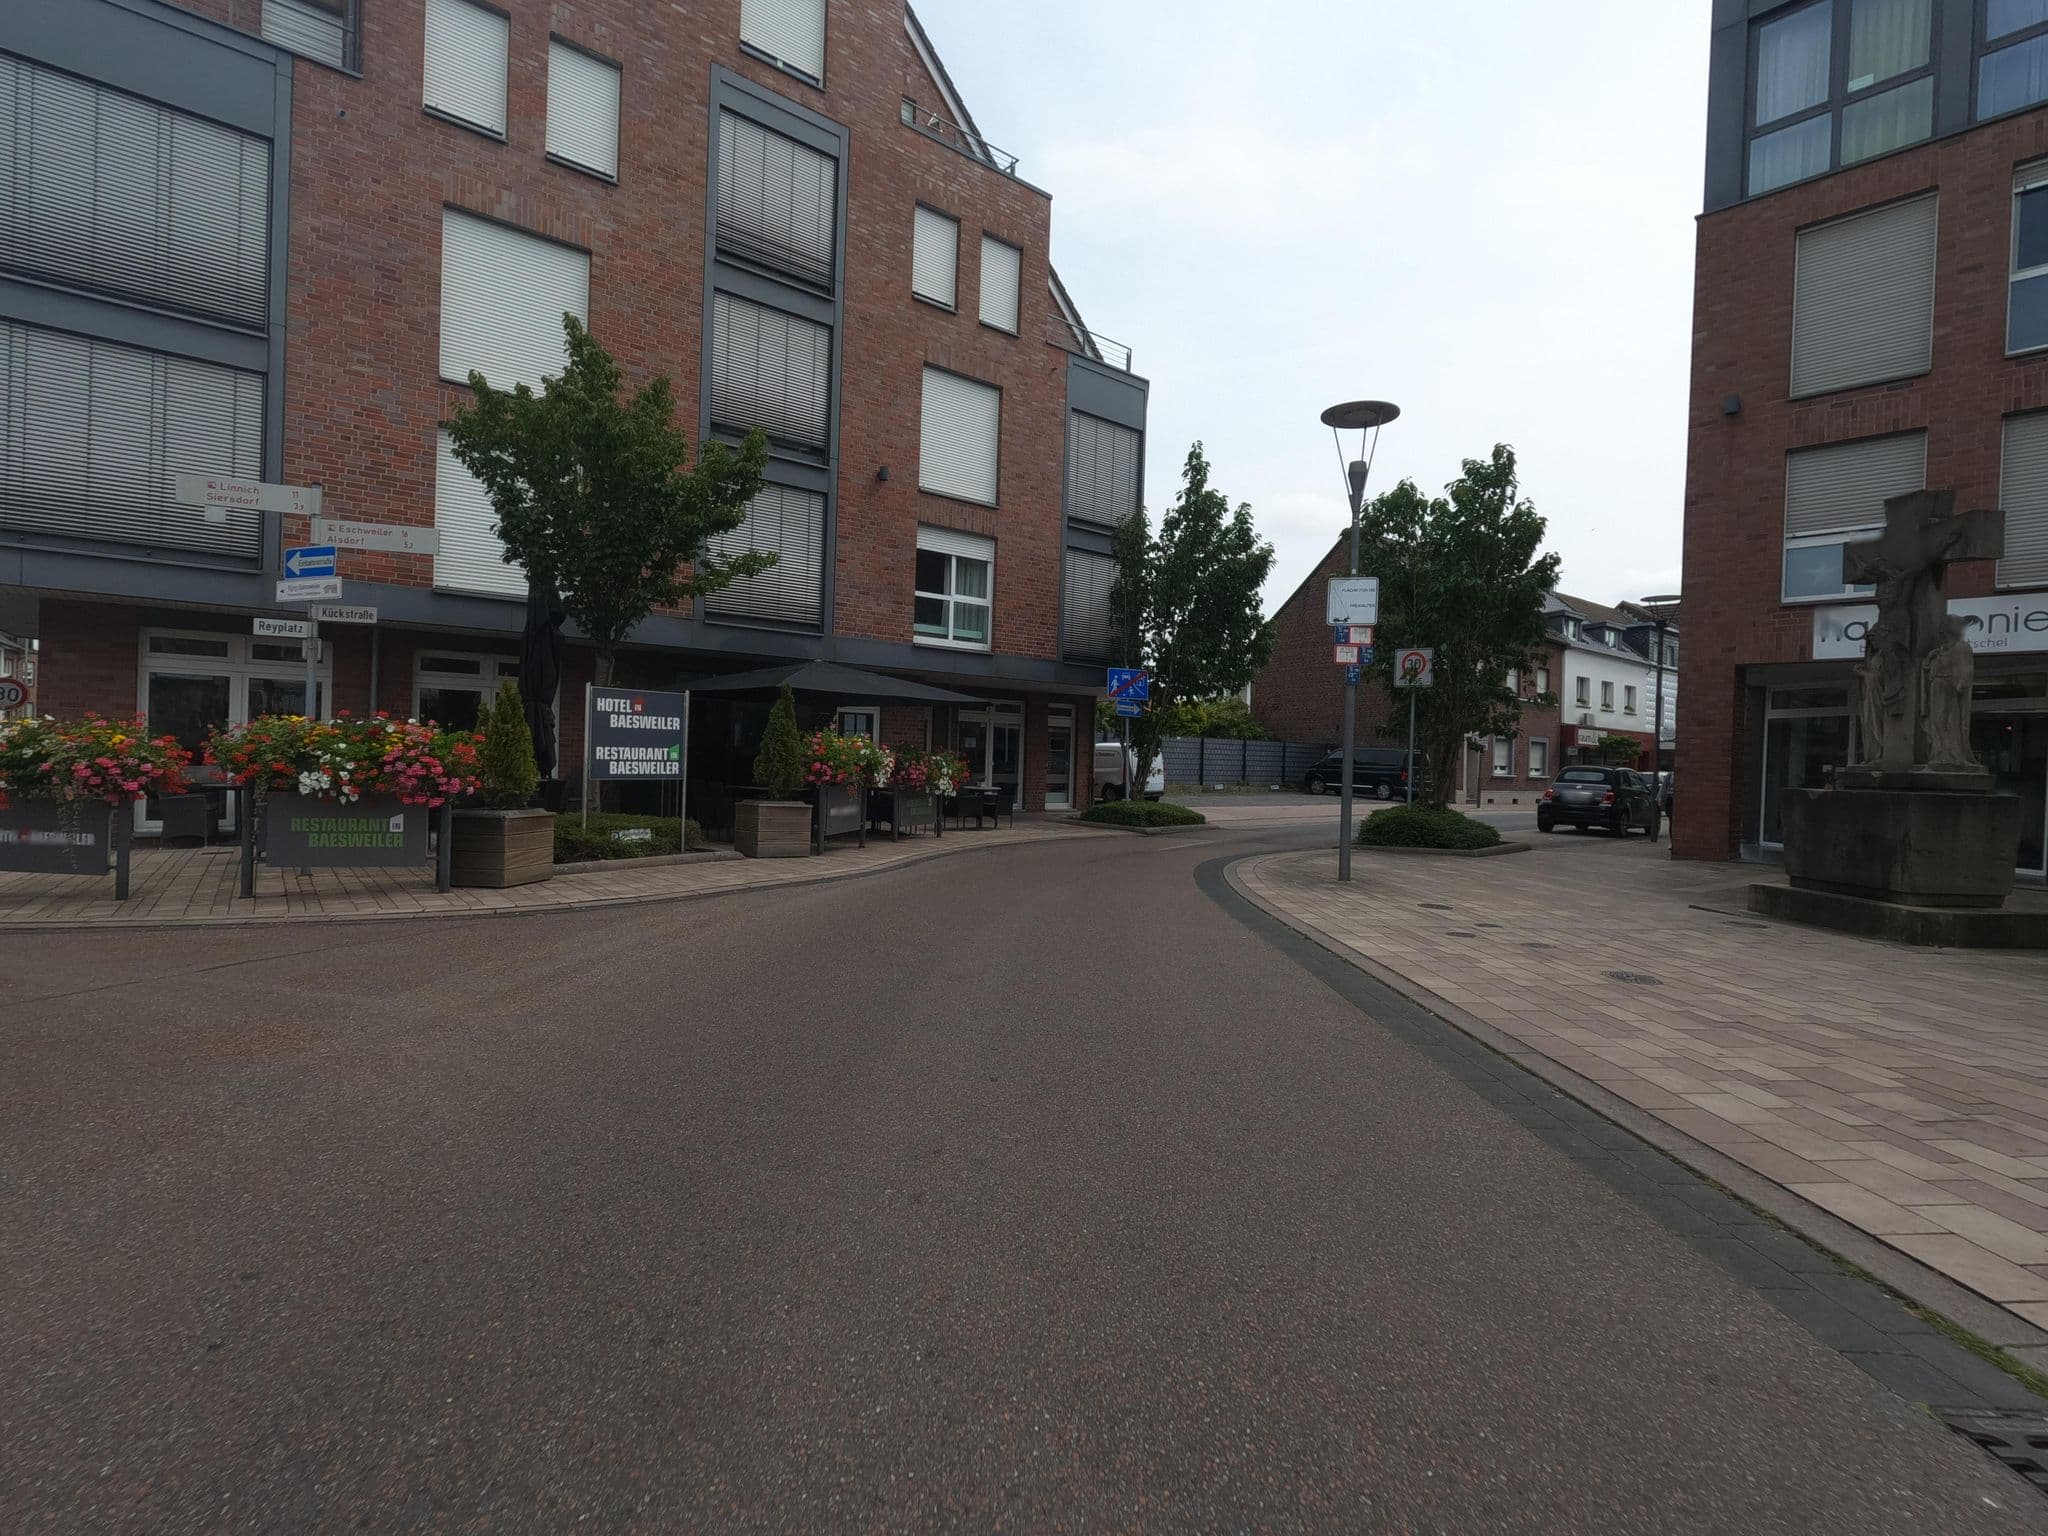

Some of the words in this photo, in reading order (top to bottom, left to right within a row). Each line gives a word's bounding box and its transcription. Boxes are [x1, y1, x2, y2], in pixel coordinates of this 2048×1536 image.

[220, 482, 260, 495] Linnich
[206, 492, 260, 506] Siersdorf
[338, 524, 393, 537] Eschweiler
[326, 535, 365, 545] Alsdorf
[322, 607, 374, 620] Kückstraße
[258, 620, 304, 634] Reyplatz
[597, 698, 633, 713] HOTEL
[610, 714, 680, 730] BAESWEILER
[595, 746, 669, 761] RESTAURANT
[609, 761, 679, 775] BAESWEILER
[291, 817, 389, 832] RESTAURANT
[308, 833, 404, 848] BAESWEILER
